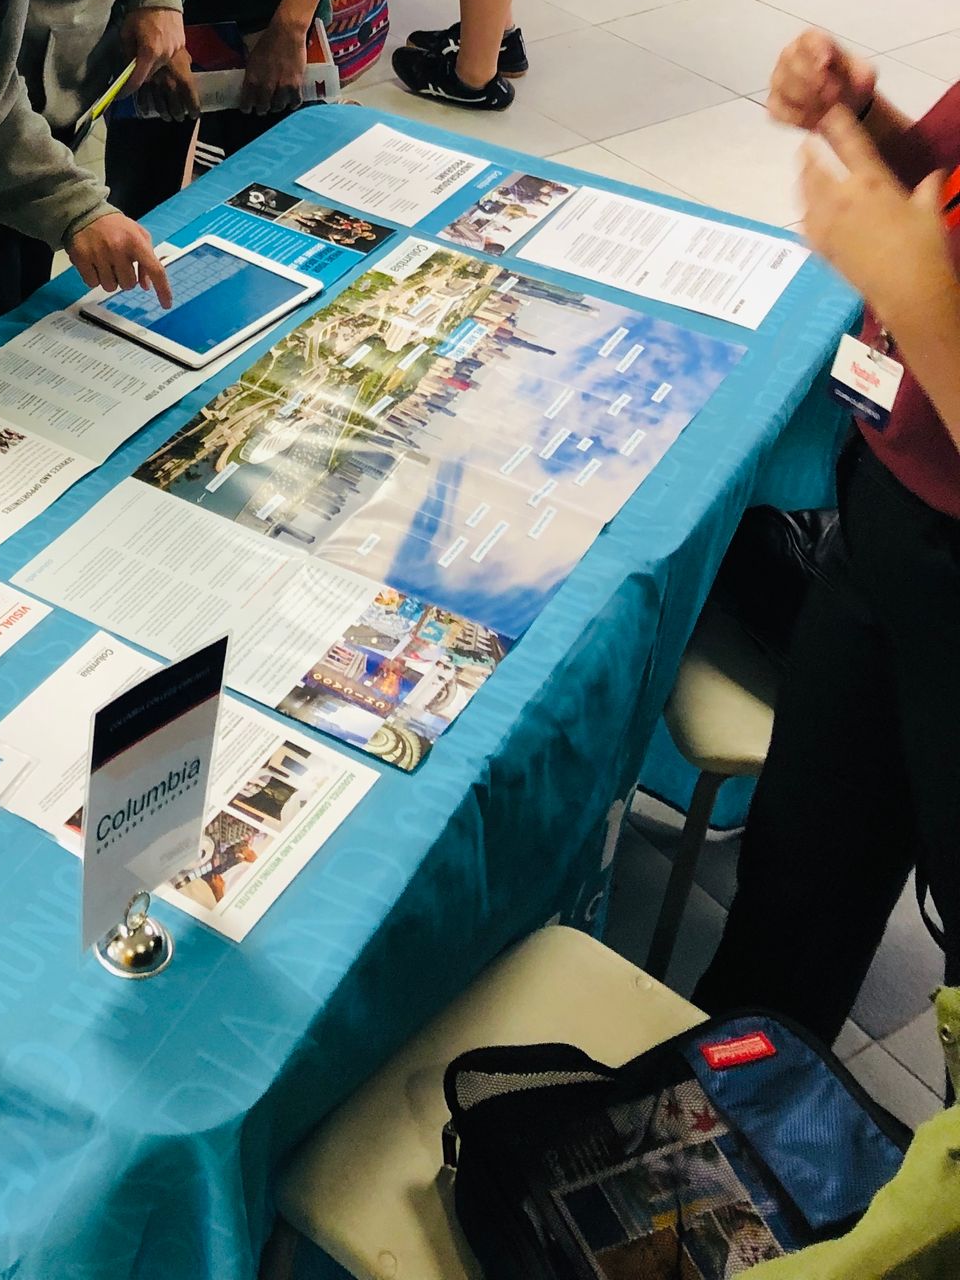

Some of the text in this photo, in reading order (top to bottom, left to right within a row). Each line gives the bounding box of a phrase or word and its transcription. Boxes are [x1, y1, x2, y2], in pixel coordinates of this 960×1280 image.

[432, 161, 476, 197] UNDERGRADUATE
[433, 156, 465, 184] PROGRAMS
[390, 243, 429, 273] Columbia
[0, 457, 76, 515] SERVICES AND OPPORTUNITIES
[2, 605, 31, 630] VISUAL
[80, 648, 114, 679] Columbia
[312, 671, 389, 711] CHICAGO
[96, 754, 201, 842] Columbia
